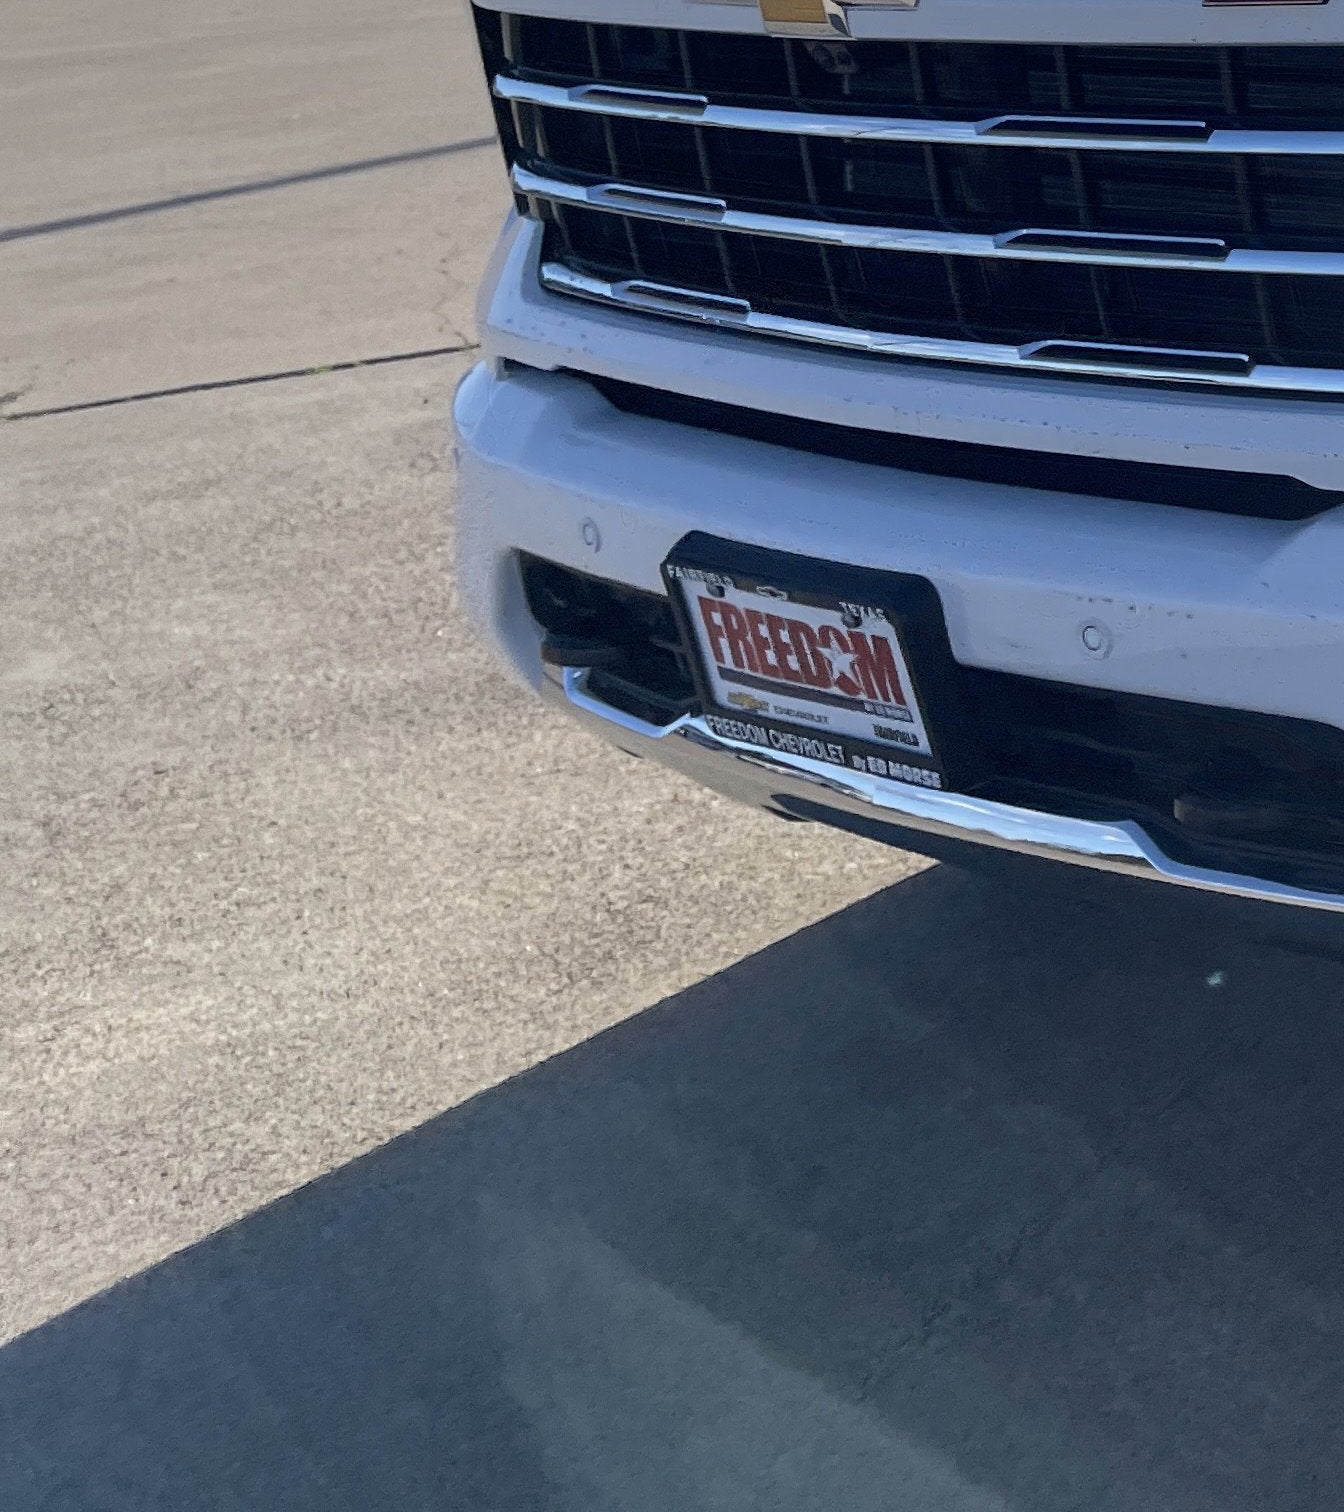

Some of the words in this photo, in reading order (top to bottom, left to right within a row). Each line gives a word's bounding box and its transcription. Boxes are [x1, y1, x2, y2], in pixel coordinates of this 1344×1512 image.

[697, 594, 907, 707] FREEDOM
[705, 714, 769, 747] FREEDOM
[767, 728, 846, 765] CHEVROLET
